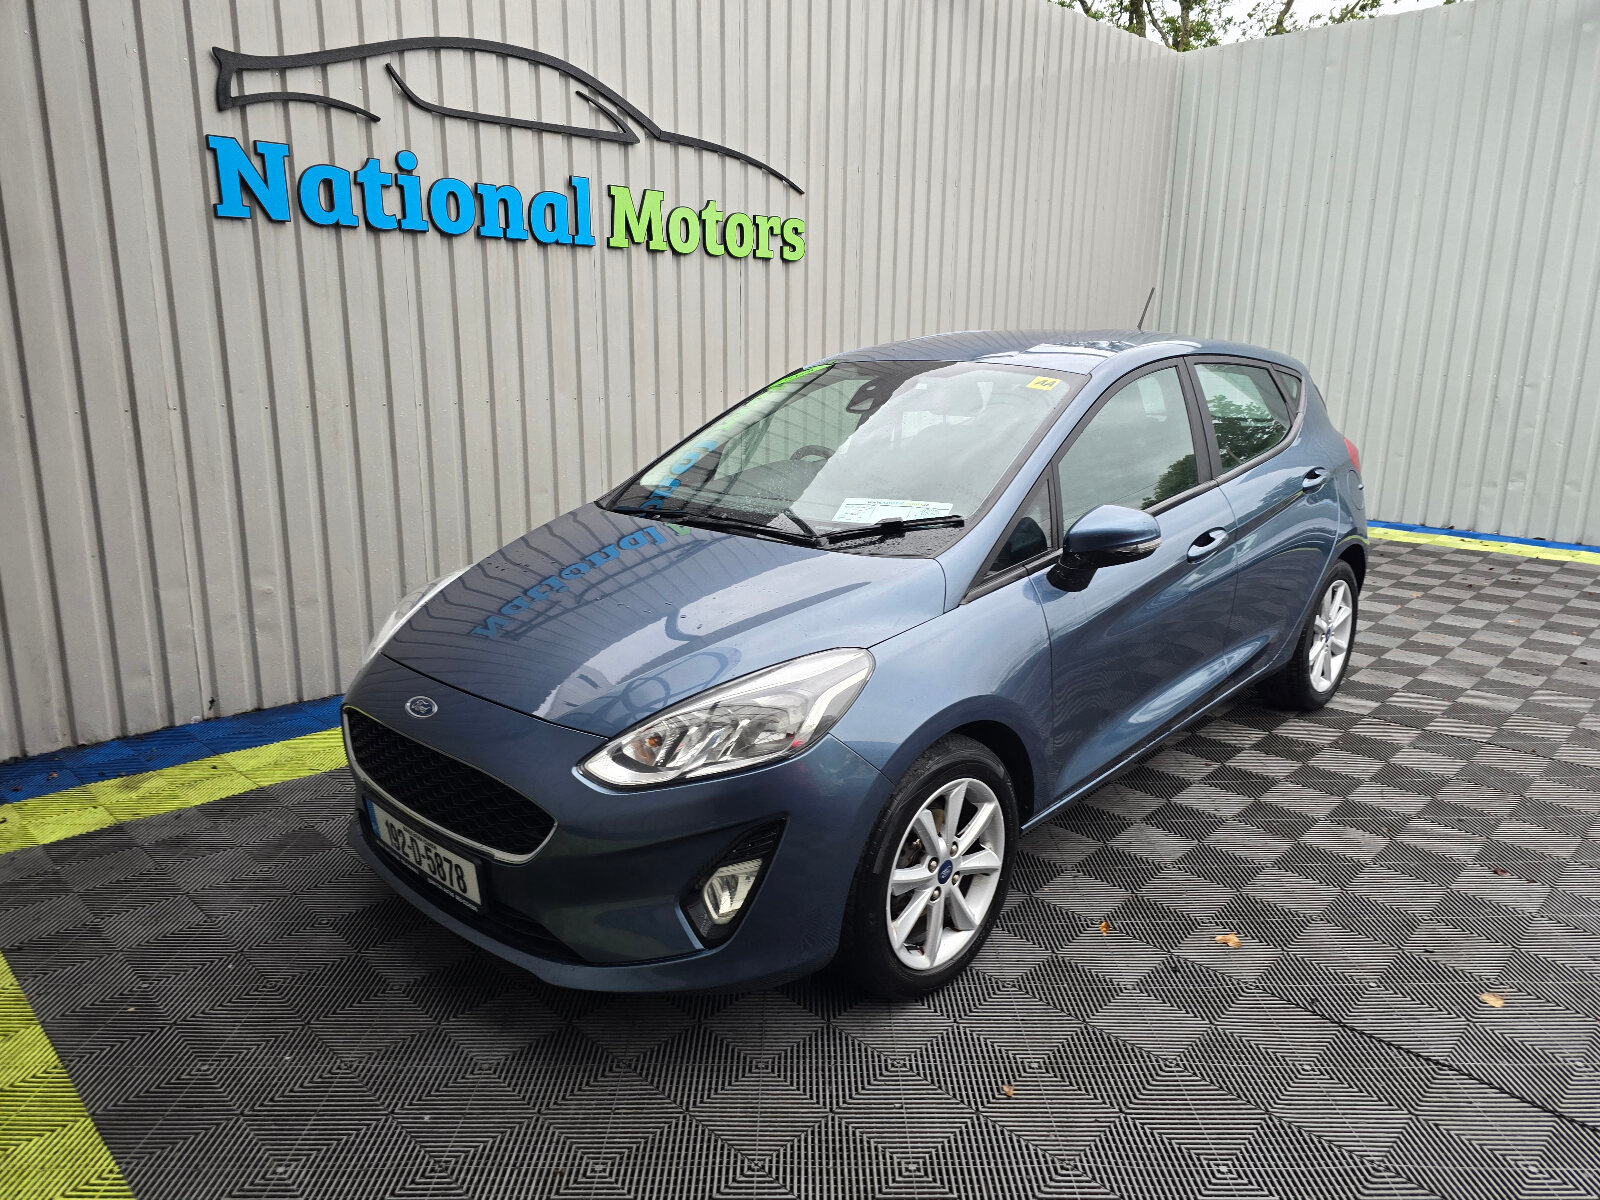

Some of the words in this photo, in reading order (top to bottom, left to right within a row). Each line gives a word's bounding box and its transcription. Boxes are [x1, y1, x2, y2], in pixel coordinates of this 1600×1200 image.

[206, 134, 595, 246] National
[607, 184, 806, 262] Motors
[385, 819, 468, 895] 192-D-5878
